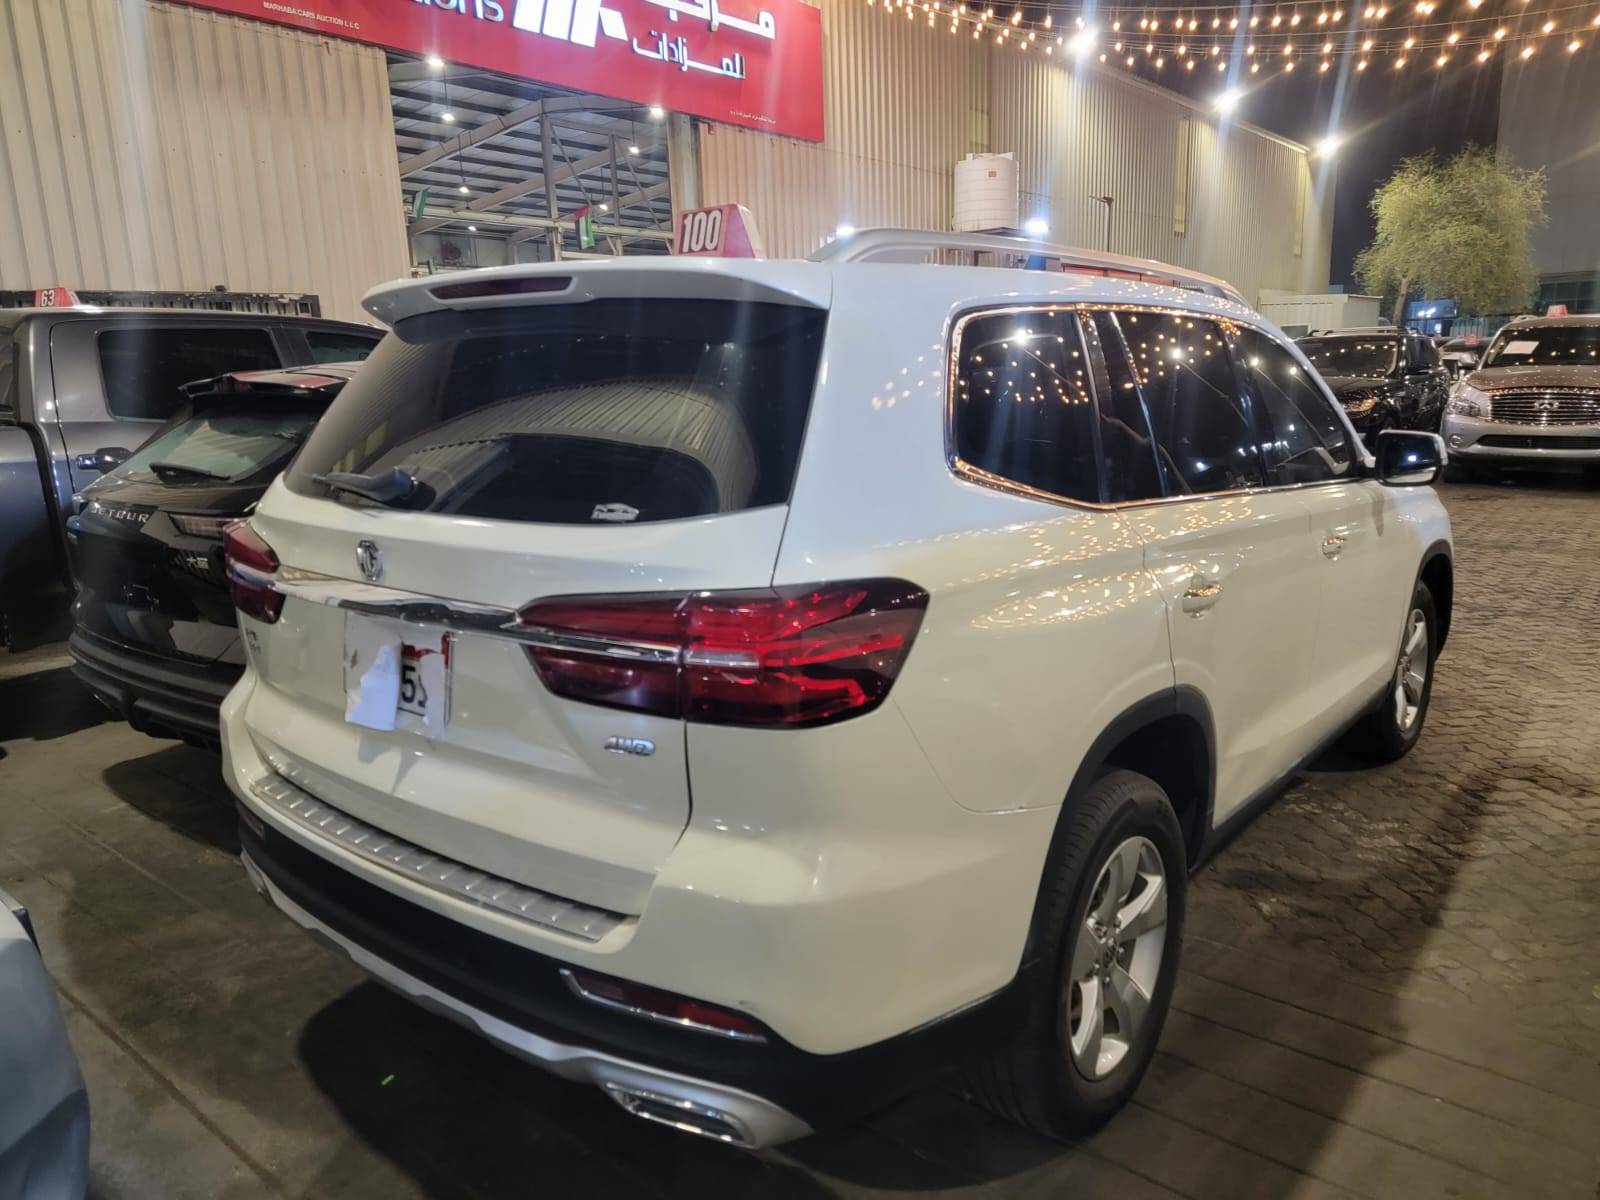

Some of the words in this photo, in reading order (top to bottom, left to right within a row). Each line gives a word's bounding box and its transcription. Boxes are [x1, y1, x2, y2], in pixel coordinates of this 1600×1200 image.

[297, 8, 316, 19] CARS
[316, 13, 344, 26] AUCTION
[682, 209, 722, 253] 100
[41, 289, 55, 307] 63
[91, 503, 150, 523] JETOUR
